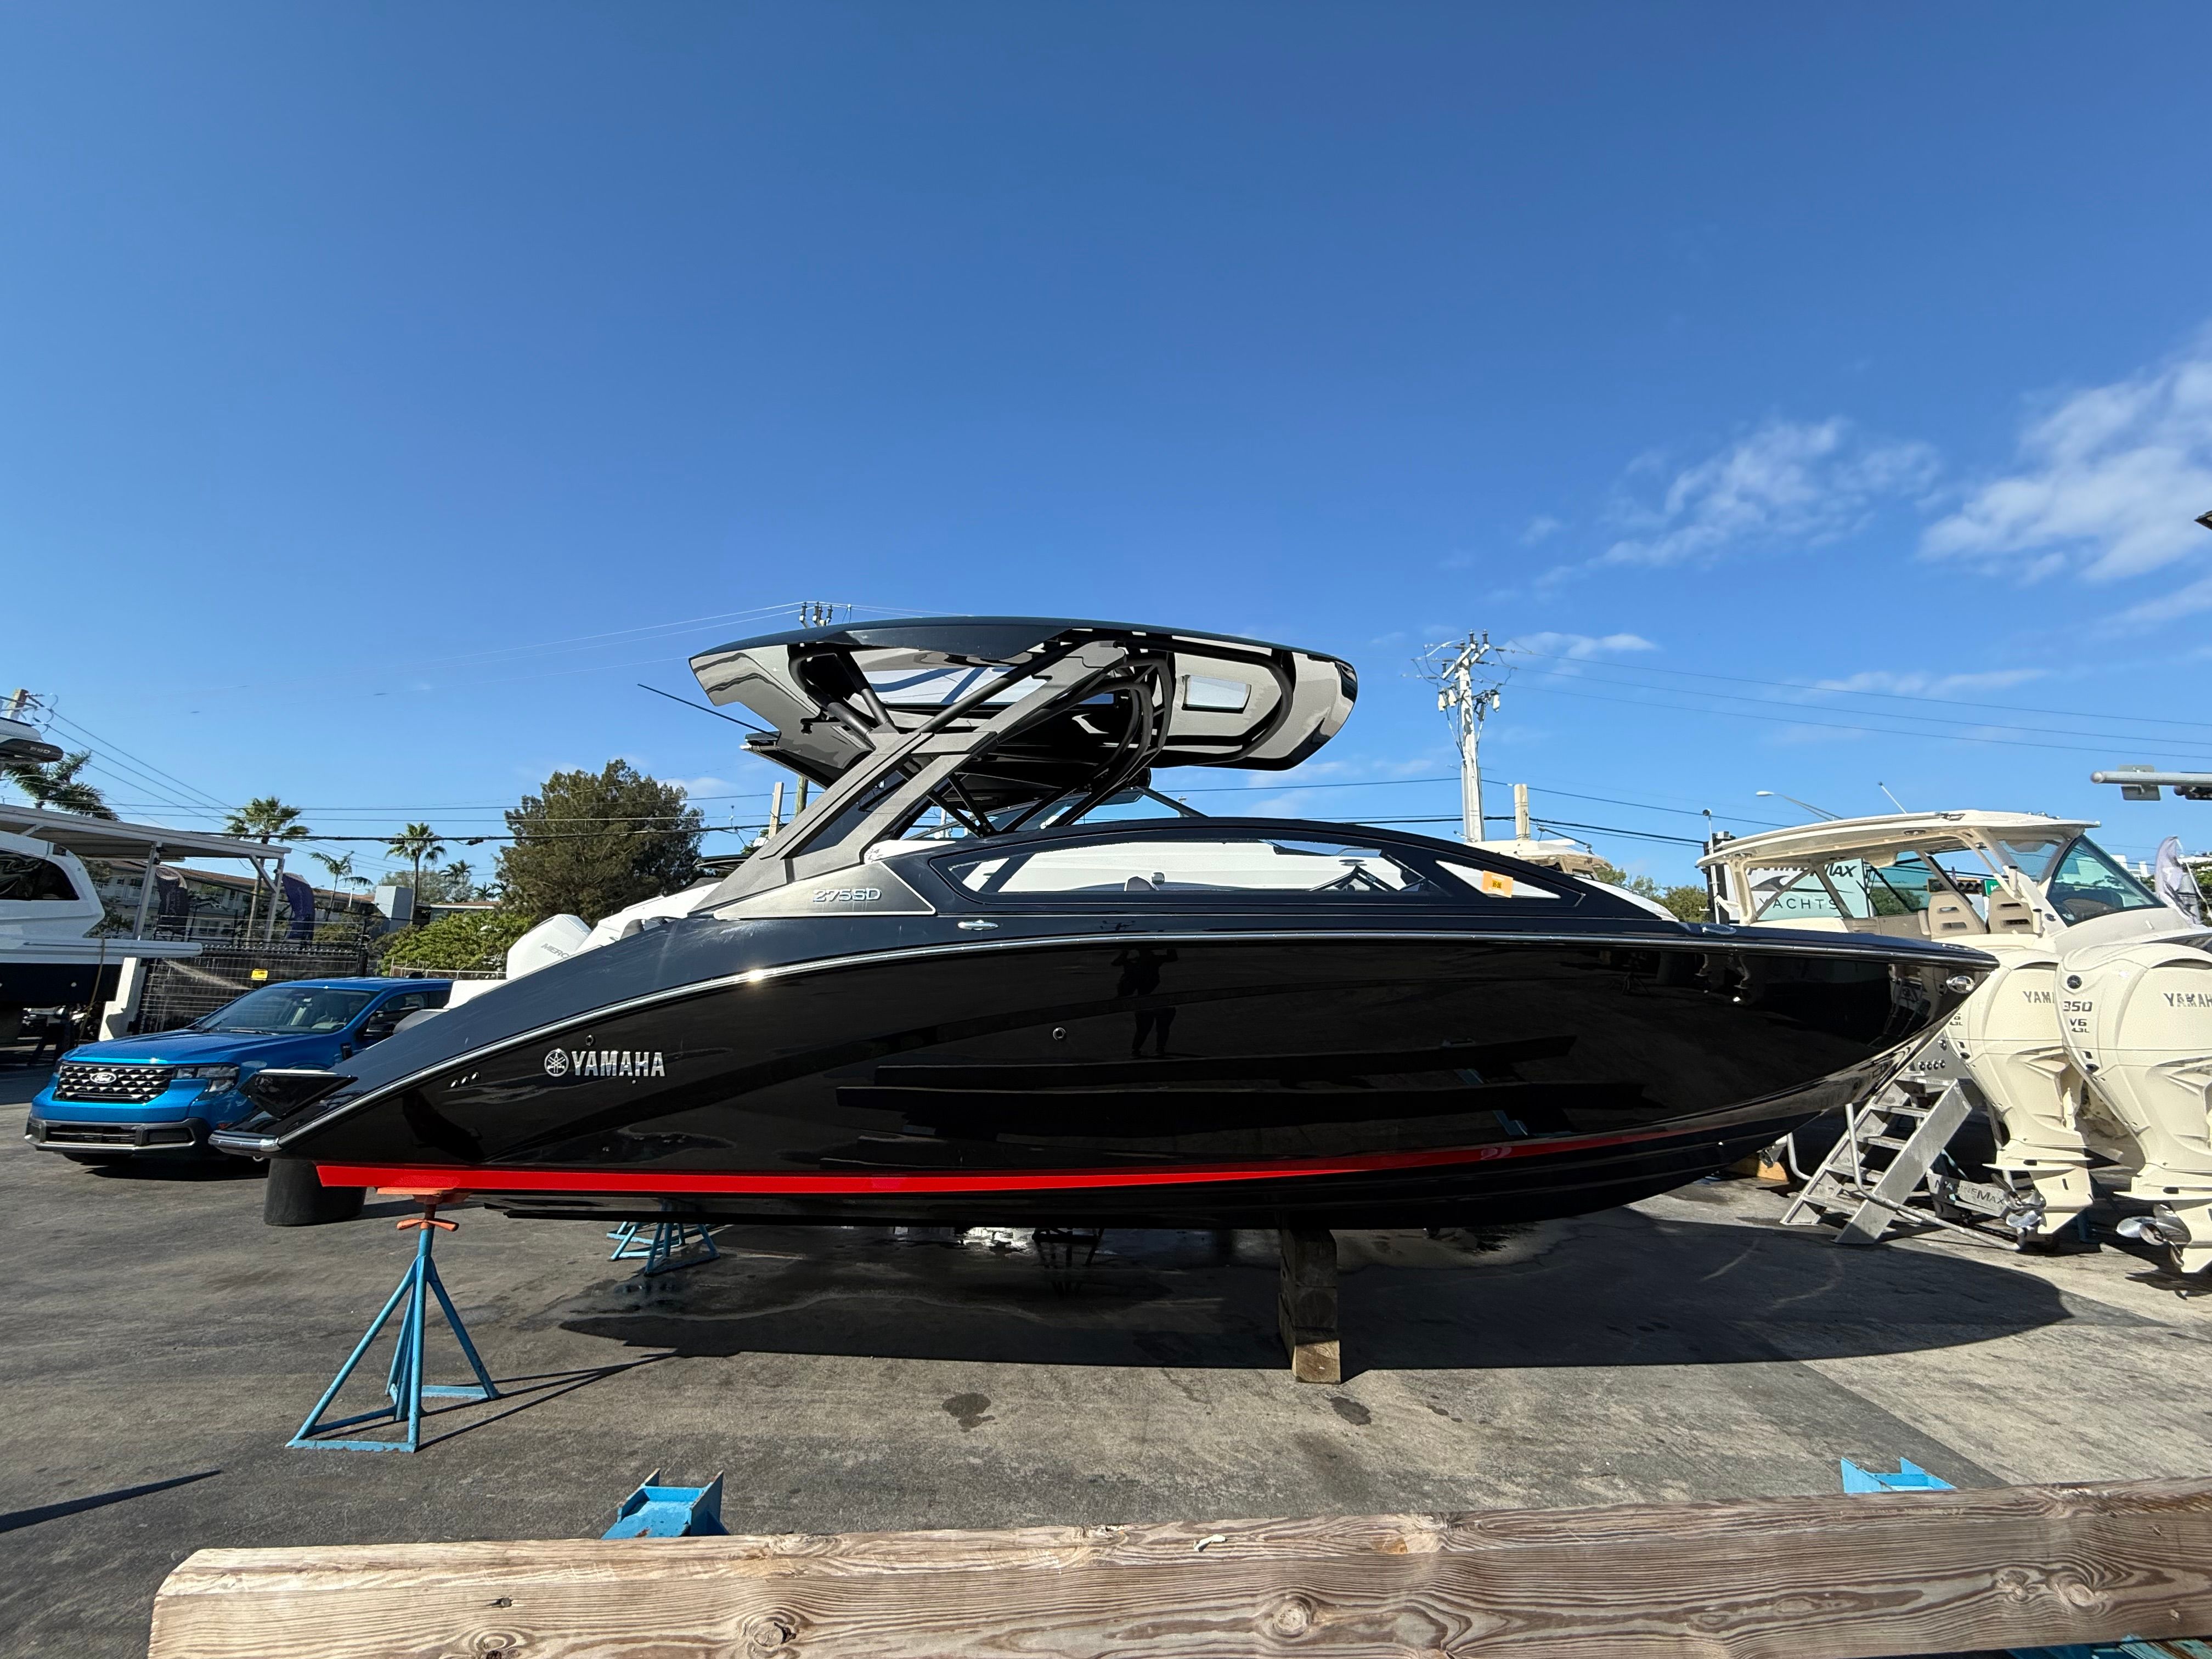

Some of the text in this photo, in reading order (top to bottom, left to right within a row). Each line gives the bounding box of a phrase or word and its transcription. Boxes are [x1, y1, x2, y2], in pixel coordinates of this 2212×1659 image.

[812, 888, 882, 902] 275SD
[2063, 1001, 2093, 1012] 350
[2069, 1018, 2087, 1026] V6
[571, 1051, 665, 1077] YAMAHA
